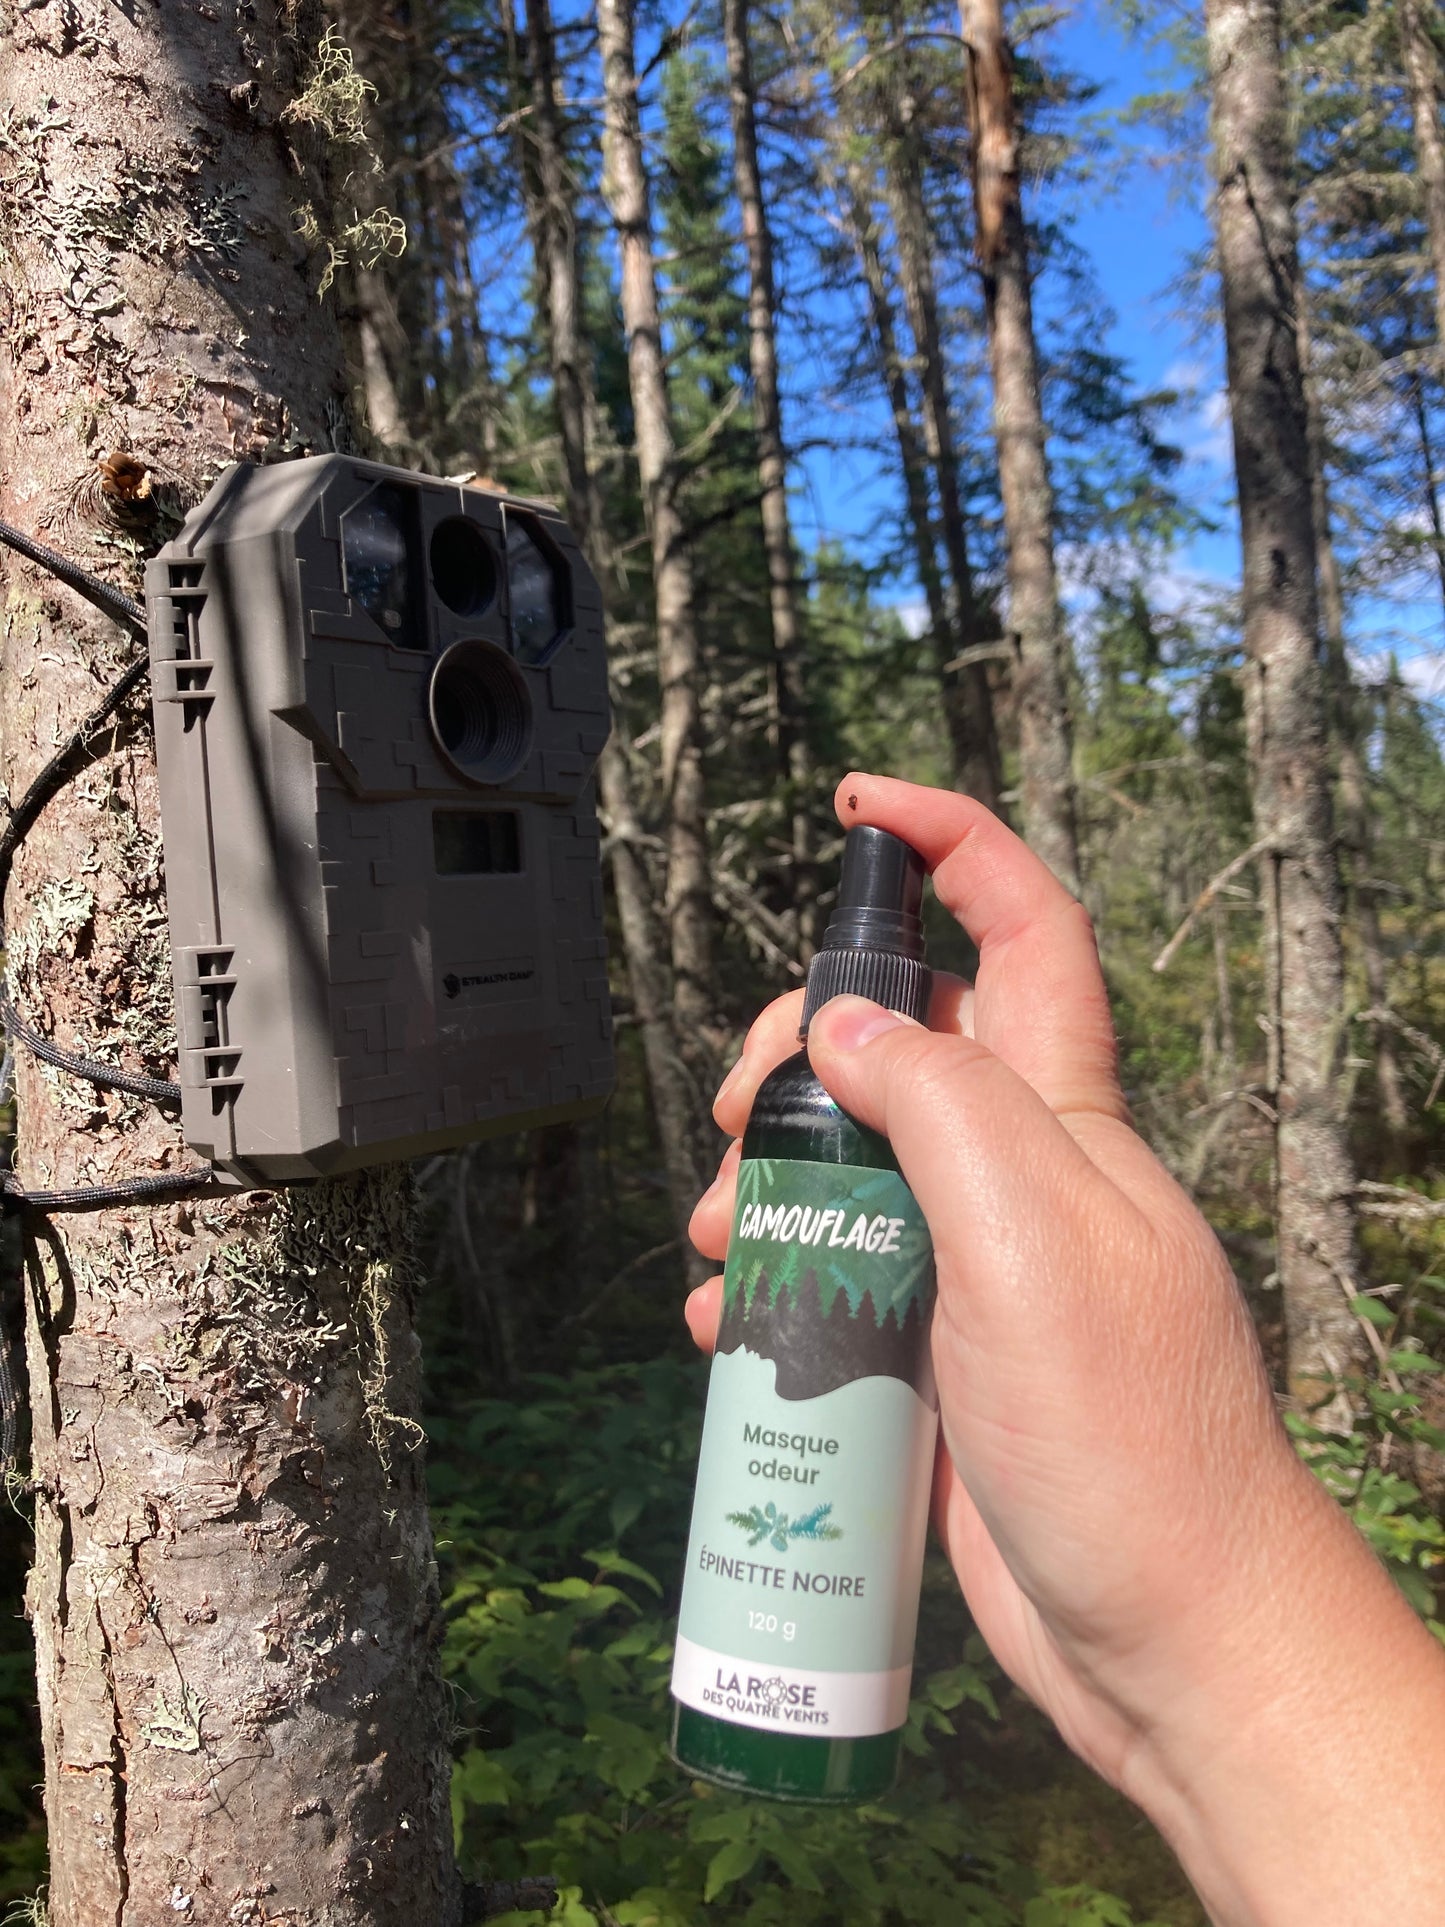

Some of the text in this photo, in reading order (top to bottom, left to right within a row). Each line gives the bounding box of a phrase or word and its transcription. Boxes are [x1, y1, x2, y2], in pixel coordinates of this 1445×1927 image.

[739, 1203, 905, 1253] CAMOUFLAGE
[743, 1422, 839, 1457] Masque
[748, 1459, 820, 1485] odeur
[699, 1544, 866, 1597] ÉPINETTE NOIRE
[748, 1611, 796, 1642] 120 g
[716, 1668, 816, 1707] LA ROSE
[703, 1688, 829, 1725] DES QUATRE VENTS
